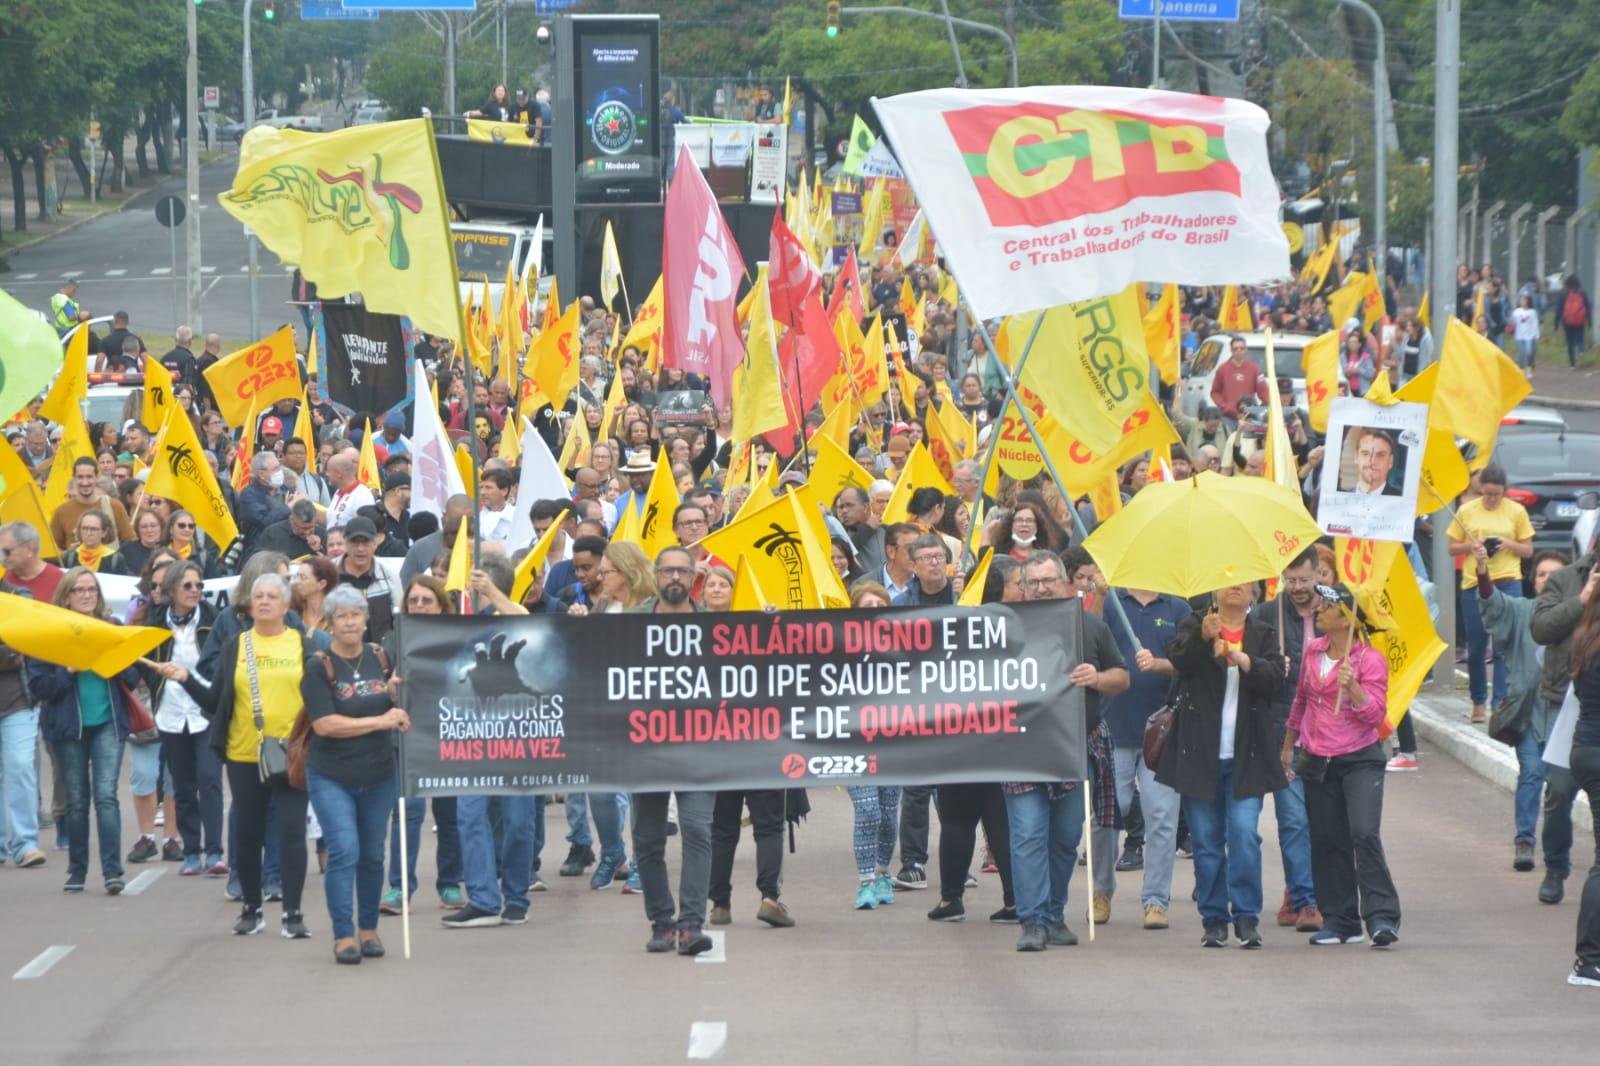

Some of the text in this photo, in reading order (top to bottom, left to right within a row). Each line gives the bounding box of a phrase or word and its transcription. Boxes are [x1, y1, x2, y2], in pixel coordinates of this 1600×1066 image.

[605, 162, 640, 170] Moderado
[986, 108, 1217, 199] CTB
[452, 232, 511, 248] RPRISE
[1003, 228, 1077, 255] Central
[1121, 211, 1238, 232] Trabalhadores
[1009, 258, 1021, 271] e
[1151, 228, 1177, 241] do
[1184, 229, 1230, 245] Brasil
[233, 360, 297, 400] CPERS
[999, 447, 1042, 463] Núcleo
[646, 615, 1008, 657] POR SALÁRIO DIGNO E EM
[608, 650, 1047, 701] DEFESA DO IPE SAÚDE PÚBLICO,
[439, 694, 564, 721] SERVIDORES
[440, 719, 564, 740] PAGANDO A CONTA
[628, 699, 1027, 744] SOLIDÁRIO E DE QUALIDADE.
[440, 738, 566, 761] MAIS UMA VEZ.
[808, 754, 867, 775] CPERS
[418, 777, 469, 788] EDUARDO
[512, 775, 518, 785] A
[521, 775, 554, 785] CULPA
[557, 773, 563, 784] É
[567, 773, 589, 784] TUA!
